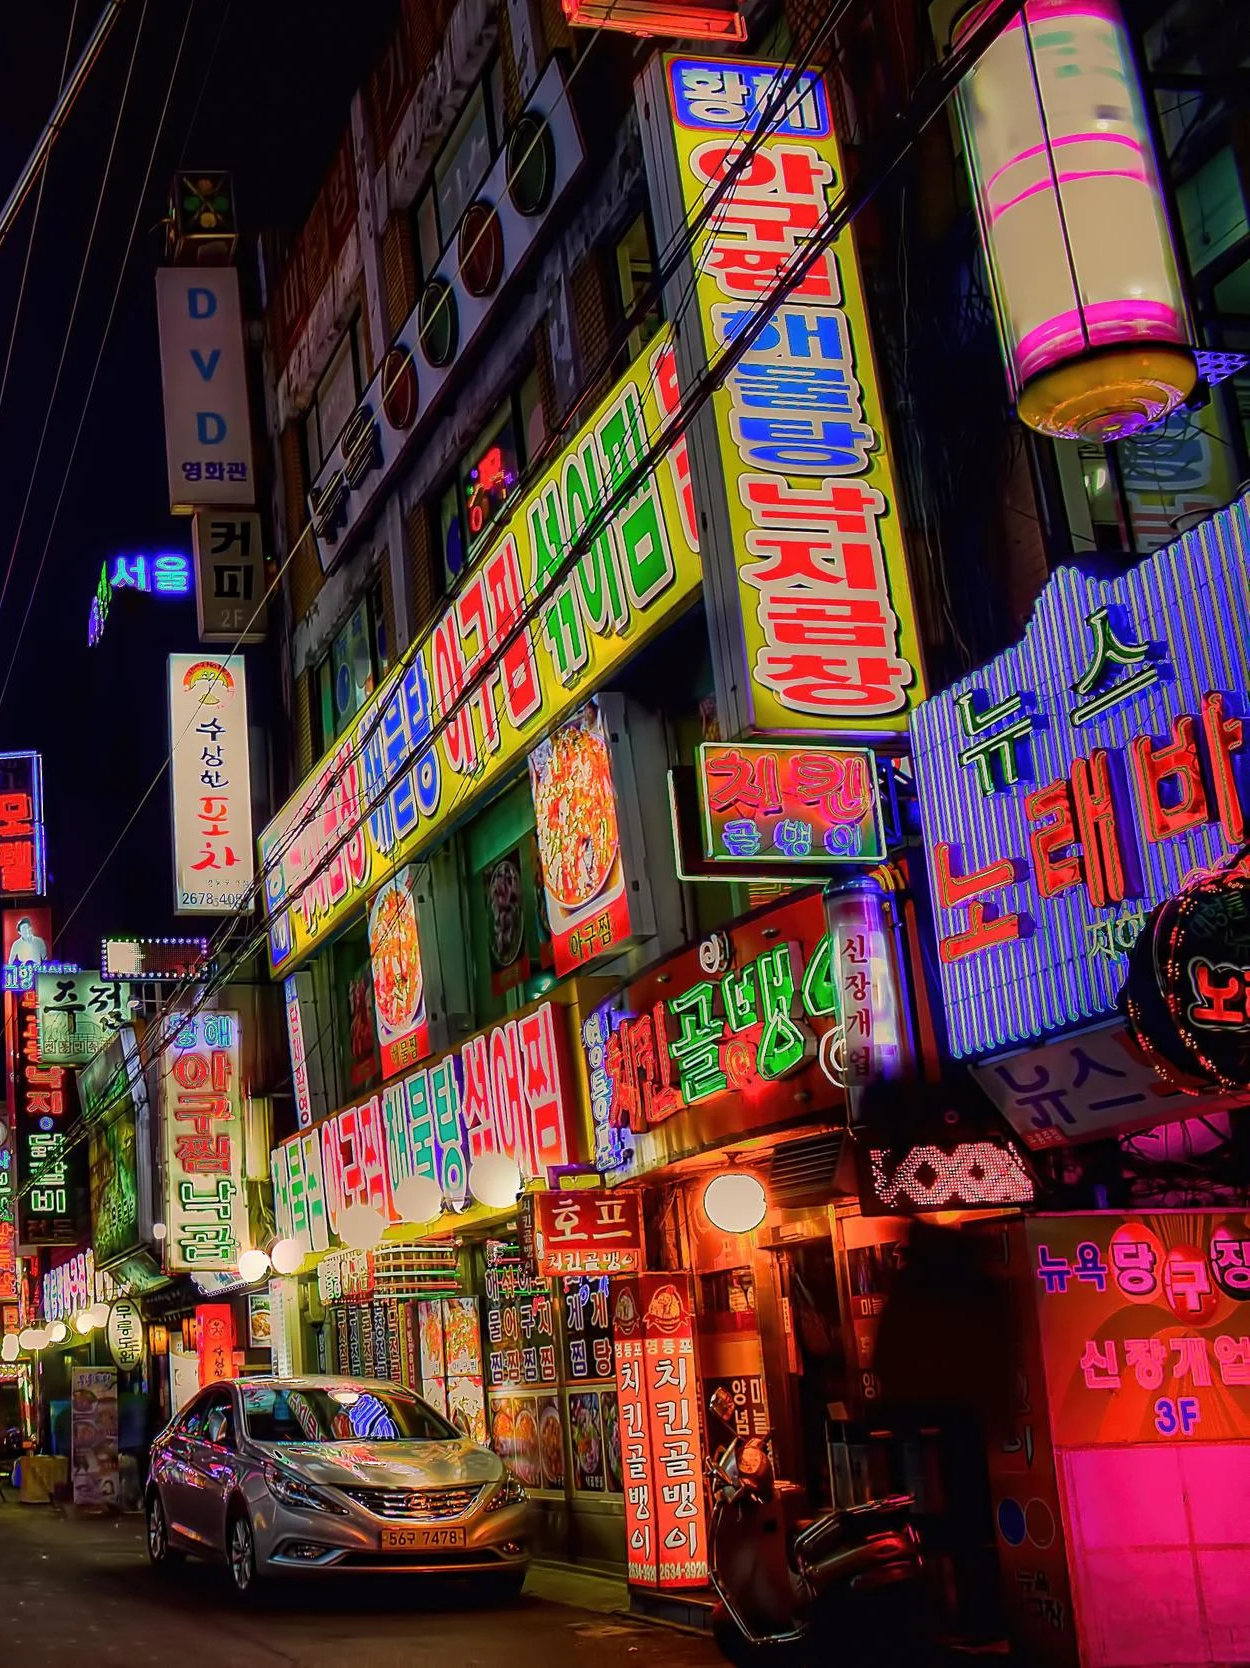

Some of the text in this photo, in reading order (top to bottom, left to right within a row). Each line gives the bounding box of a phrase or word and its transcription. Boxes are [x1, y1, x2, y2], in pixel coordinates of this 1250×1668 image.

[680, 66, 823, 132] 황해
[698, 147, 836, 300] 아구찜
[188, 288, 227, 444] DVD
[720, 312, 870, 467] 해물탕
[182, 461, 248, 482] 영화관
[110, 555, 188, 593] 서울
[210, 522, 253, 600] 커피
[747, 481, 907, 713] 낙지곱창
[221, 610, 244, 628] 2F
[432, 534, 543, 772] 아구찜
[959, 607, 1157, 797] 뉴스
[196, 718, 230, 789] 수상한
[706, 749, 871, 823] 치킨
[191, 797, 240, 870] 포차
[722, 818, 862, 857] 골뱅이
[182, 892, 255, 906] 2678-40
[570, 913, 613, 959] 아구찜
[841, 935, 872, 1077] 신장개업
[173, 1051, 234, 1174] 아구찜
[549, 1199, 632, 1243] 호프
[546, 1251, 638, 1273] 치킨골뱅이
[1037, 1244, 1107, 1294] 뉴욕
[566, 1276, 587, 1377] 게찜
[588, 1276, 612, 1377] 게탕
[1080, 1334, 1250, 1391] 신장개업
[1154, 1398, 1202, 1434] 3F
[620, 1361, 651, 1560] 치킨골뱅이
[654, 1358, 698, 1558] 치킨골뱅이
[422, 1531, 457, 1545] 7478
[660, 1562, 707, 1580] 2634-3920
